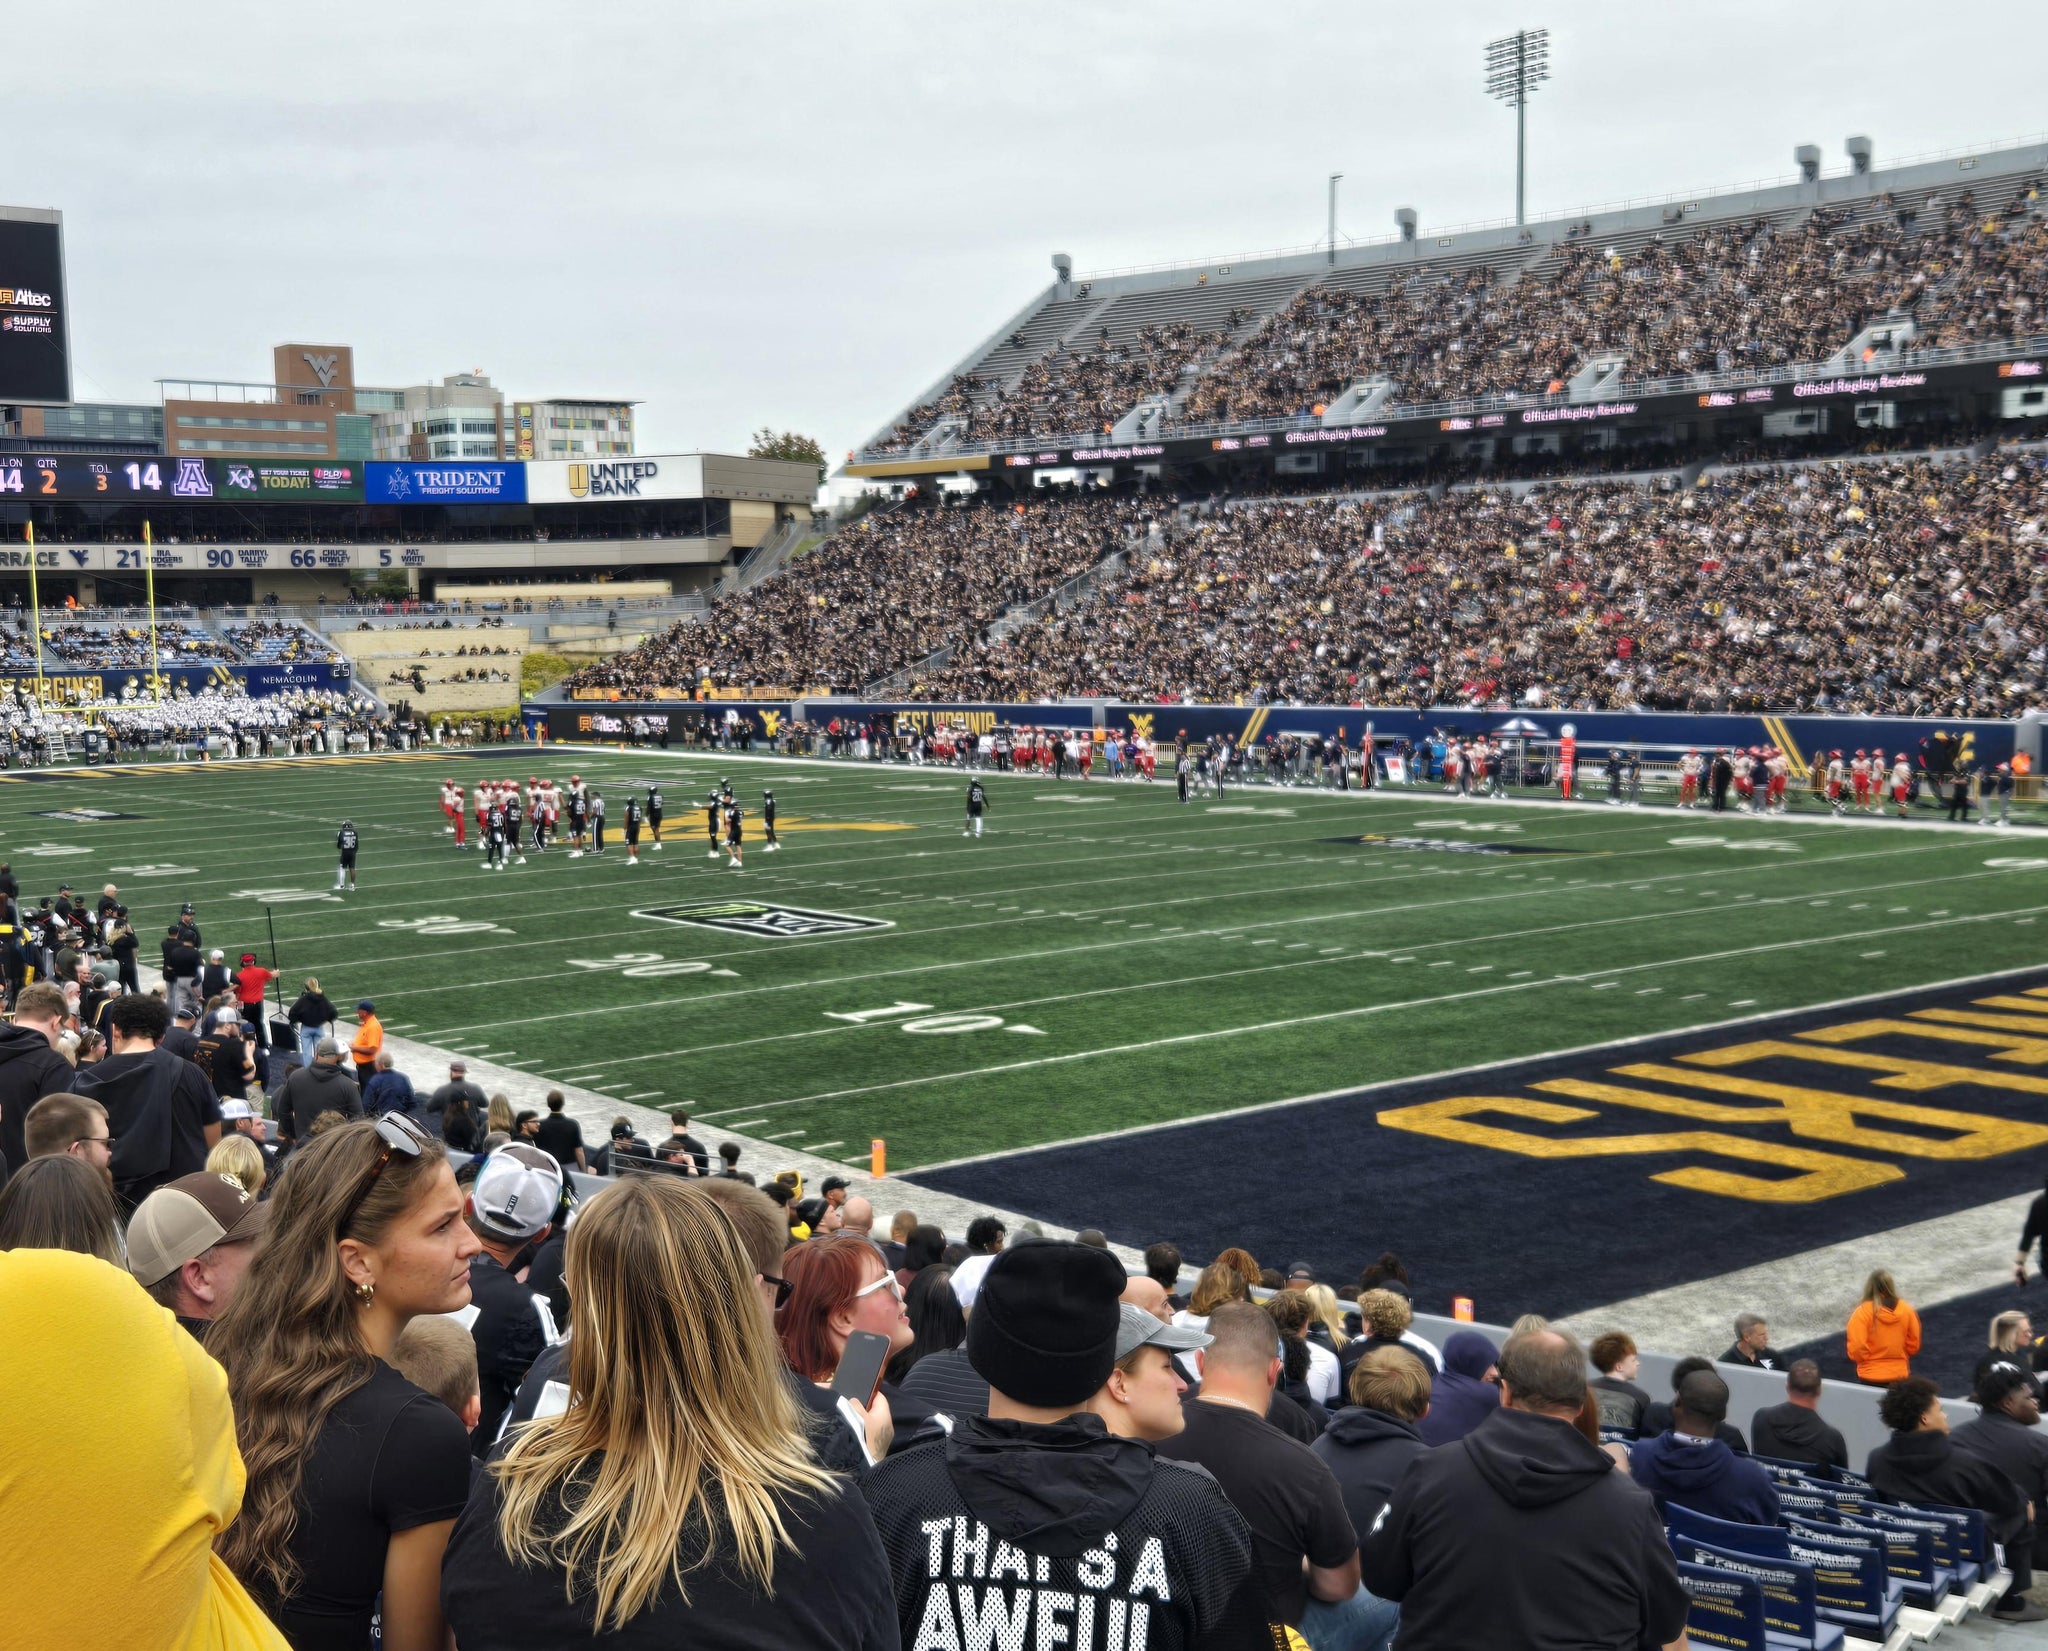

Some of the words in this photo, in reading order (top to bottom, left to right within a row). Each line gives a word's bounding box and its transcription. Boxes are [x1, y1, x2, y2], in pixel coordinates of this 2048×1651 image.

[15, 289, 51, 307] Altec
[13, 316, 51, 326] SUPPLY
[13, 325, 52, 333] SOLUTIONS
[1793, 380, 1834, 397] Official
[1522, 409, 1558, 423] Official
[1560, 406, 1596, 422] Replay
[1598, 402, 1638, 416] Review
[1286, 430, 1318, 444] Official
[1319, 428, 1351, 442] Replay
[1351, 426, 1387, 438] Review
[1072, 449, 1101, 462] Official
[1102, 447, 1131, 461] Replay
[1132, 445, 1164, 457] Review
[37, 458, 58, 468] QTR
[590, 462, 658, 479] UNITED
[41, 470, 58, 494] 2
[96, 474, 108, 491] 3
[126, 463, 163, 491] 14
[261, 476, 311, 489] TODAY!
[414, 471, 506, 487] TRIDENT
[422, 487, 455, 495] FREIGHT
[456, 487, 500, 495] SOLUTIONS
[591, 479, 641, 496] BANK
[117, 550, 142, 568] 21
[206, 549, 234, 568] 90
[290, 549, 317, 568] 66
[322, 549, 348, 557] CHUCK
[379, 549, 393, 567] 5
[401, 555, 426, 563] WHITE
[333, 664, 350, 677] 25
[262, 675, 318, 684] NEMACOLIN
[343, 836, 357, 849] 36
[565, 952, 713, 977] 20
[822, 1001, 1005, 1034] 10
[1128, 1537, 1171, 1602] A
